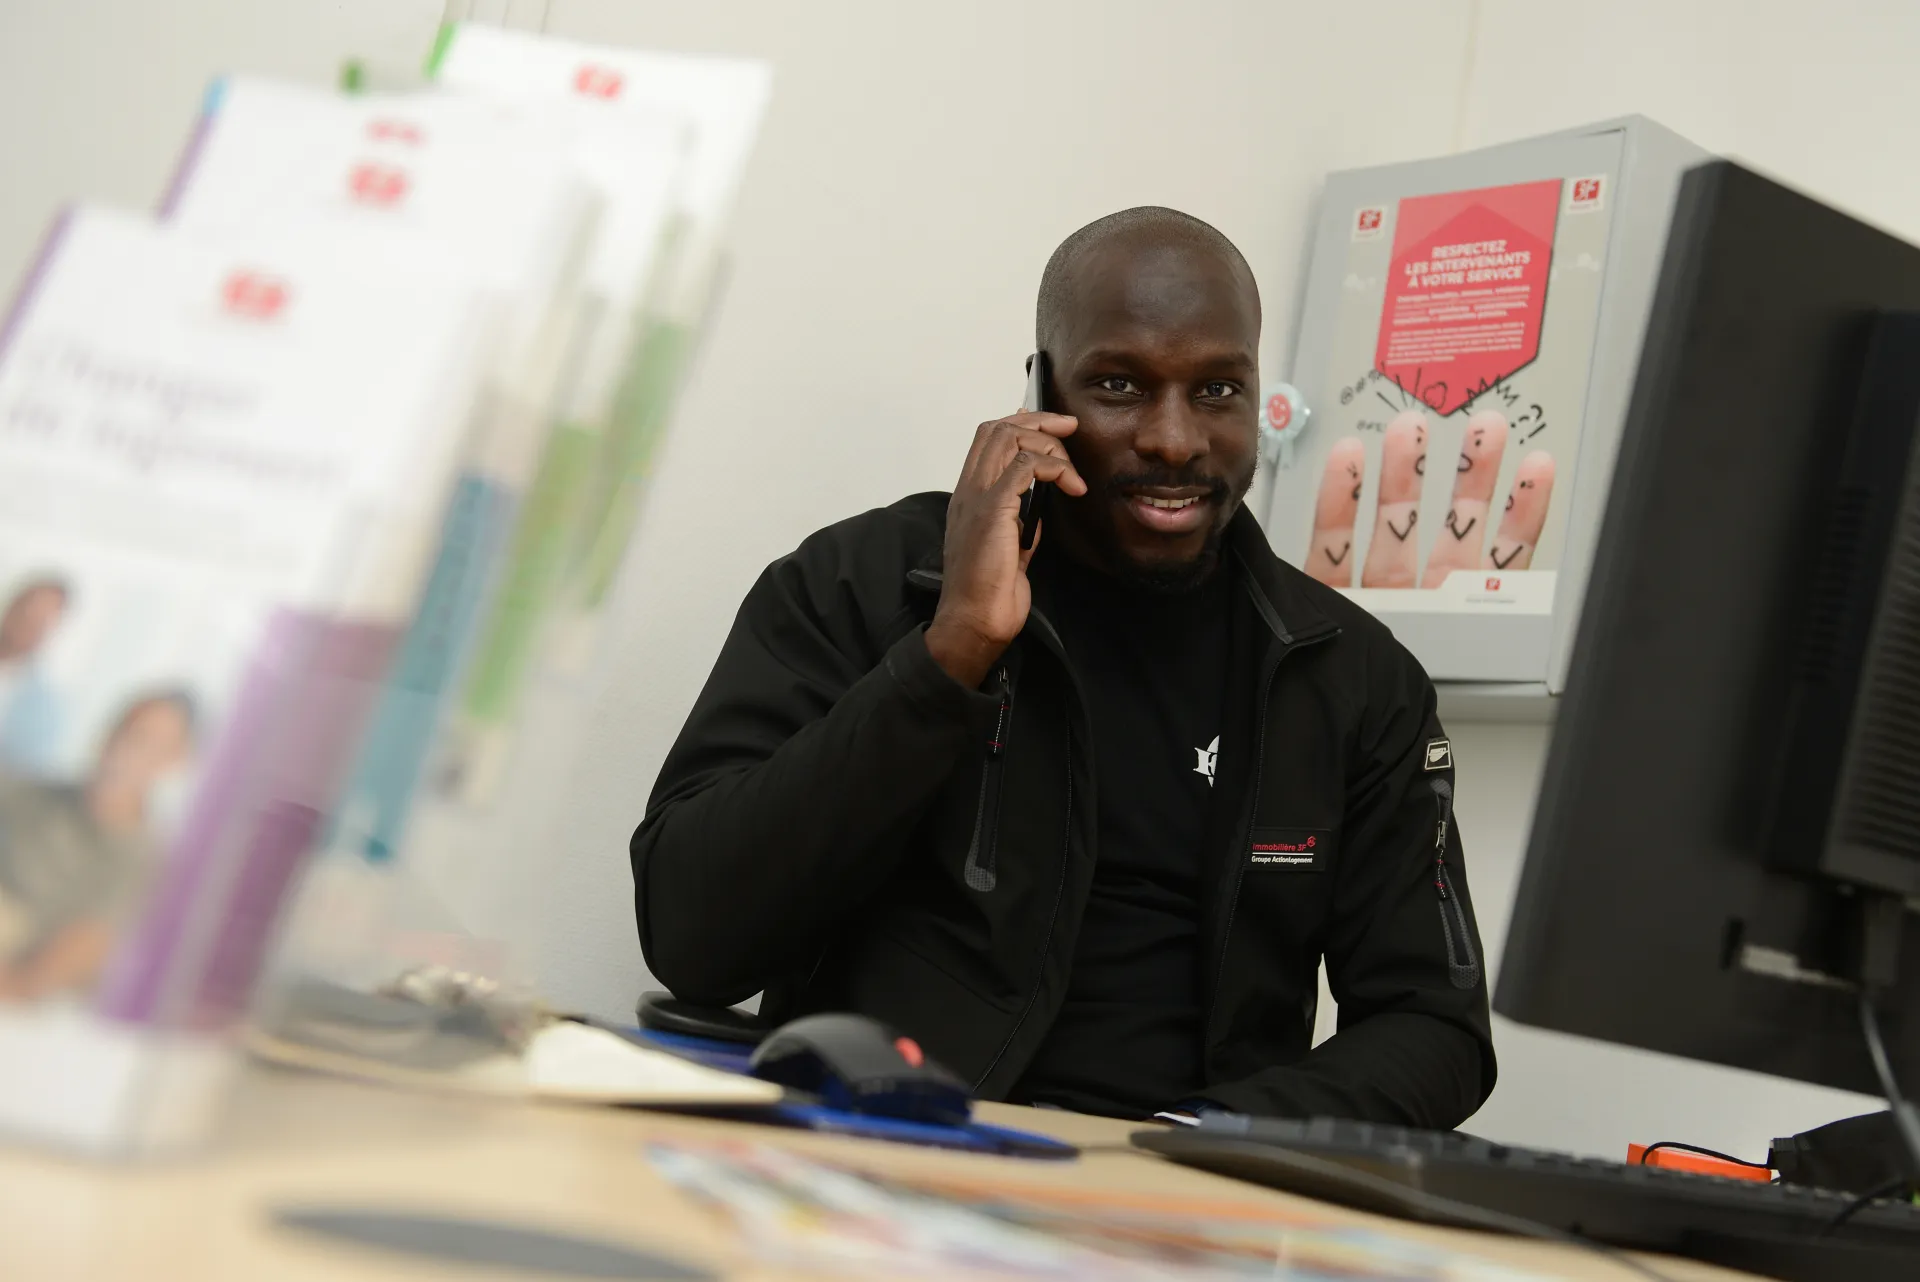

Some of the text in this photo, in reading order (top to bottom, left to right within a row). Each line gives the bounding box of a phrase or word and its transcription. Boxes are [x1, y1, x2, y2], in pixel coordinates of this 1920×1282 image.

[1432, 240, 1507, 258] RESPECTEZ
[1405, 251, 1531, 275] LES INTERVENANTS
[1422, 271, 1464, 287] VOTRE
[1467, 265, 1523, 283] SERVICE
[1297, 844, 1307, 852] 3F
[1251, 856, 1313, 864] Groupe ActionLogement
